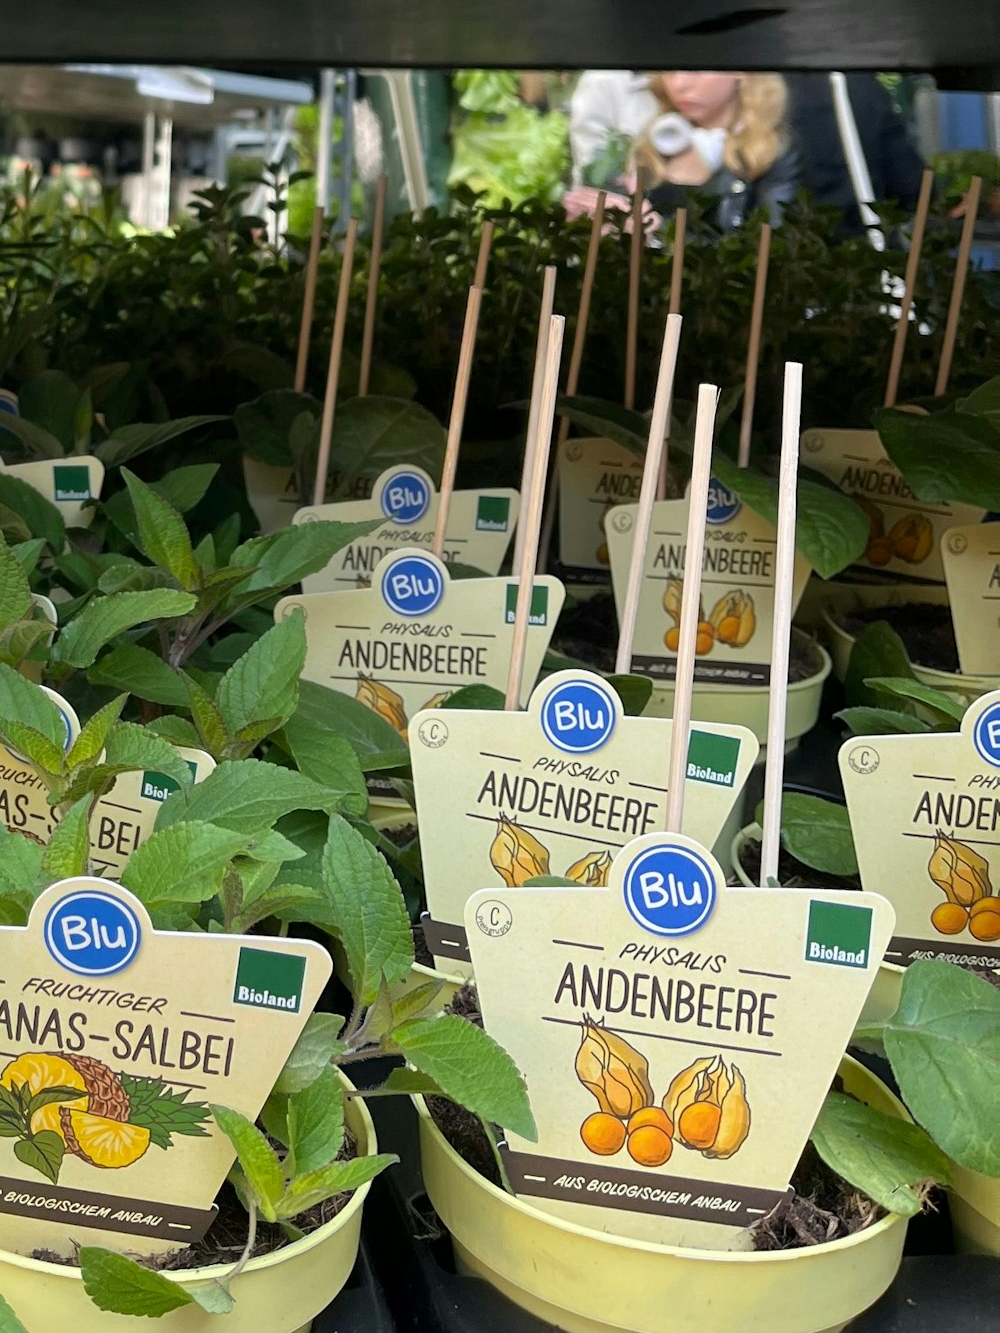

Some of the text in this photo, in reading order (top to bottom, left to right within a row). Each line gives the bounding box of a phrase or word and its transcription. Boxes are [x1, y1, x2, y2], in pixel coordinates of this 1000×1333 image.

[389, 487, 424, 511] Blu
[392, 574, 436, 600] Blu
[380, 622, 453, 638] PHYSALIS
[339, 639, 487, 677] ANDENBEERE
[554, 700, 605, 732] Blu
[430, 723, 439, 740] C
[532, 756, 620, 786] PHYSALIS
[860, 750, 869, 766] C
[687, 762, 733, 785] Bioland
[477, 770, 659, 836] ANDENBEERE
[639, 870, 702, 910] Blu
[476, 916, 513, 937] Preisgruppe
[490, 906, 500, 926] C
[60, 915, 127, 951] Blu
[619, 942, 727, 974] PHYSALIS
[809, 941, 865, 965] Bioland
[22, 977, 168, 1016] FRUCHTIGER
[238, 985, 297, 1010] Bioland
[554, 962, 778, 1038] ANDENBEERE
[3, 1190, 110, 1218] BIOLOGISCHEM
[110, 1208, 163, 1227] ANBAU
[553, 1174, 741, 1213] AUS BIOLOGISCHEM ANBAU
